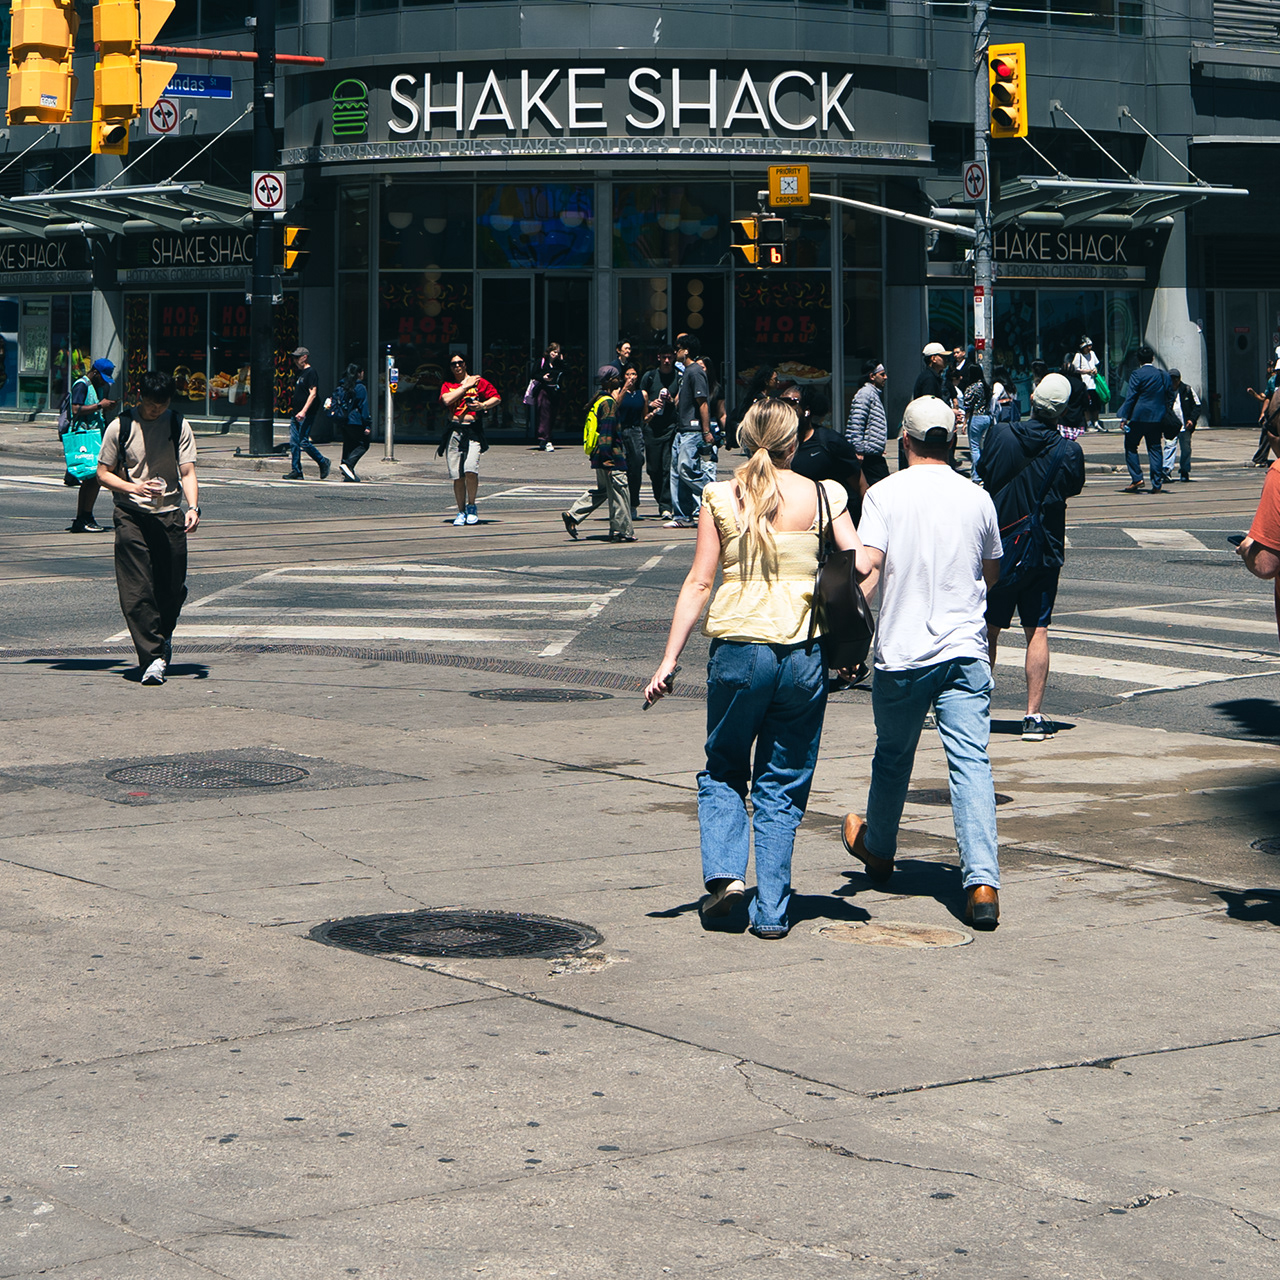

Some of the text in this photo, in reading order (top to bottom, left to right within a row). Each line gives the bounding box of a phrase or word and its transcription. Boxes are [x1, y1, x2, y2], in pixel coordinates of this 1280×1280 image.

[166, 76, 205, 93] undas
[387, 67, 856, 134] SHAKE SHACK
[333, 143, 375, 159] FROZEN
[376, 141, 441, 157] CUSTARD
[449, 138, 491, 155] FRIES
[500, 137, 567, 153] SHAKES
[576, 137, 611, 153] HOT
[619, 137, 669, 153] DOGS
[679, 138, 783, 154] CONCRETES
[792, 139, 846, 155] FLOATS
[851, 142, 884, 157] BEER
[775, 167, 802, 176] PRIORITY
[775, 195, 804, 205] CROSSING
[18, 242, 67, 269] SHACK
[152, 234, 253, 264] SHAKE SHAC
[993, 231, 1127, 261] HAKE SHACK
[1007, 264, 1049, 276] FROZEN
[1050, 264, 1098, 277] CUSTARD
[1102, 265, 1128, 278] FRIES
[163, 306, 197, 325] HOT
[755, 315, 813, 334] HOT
[399, 317, 456, 334] HOT
[755, 333, 809, 343] MENU
